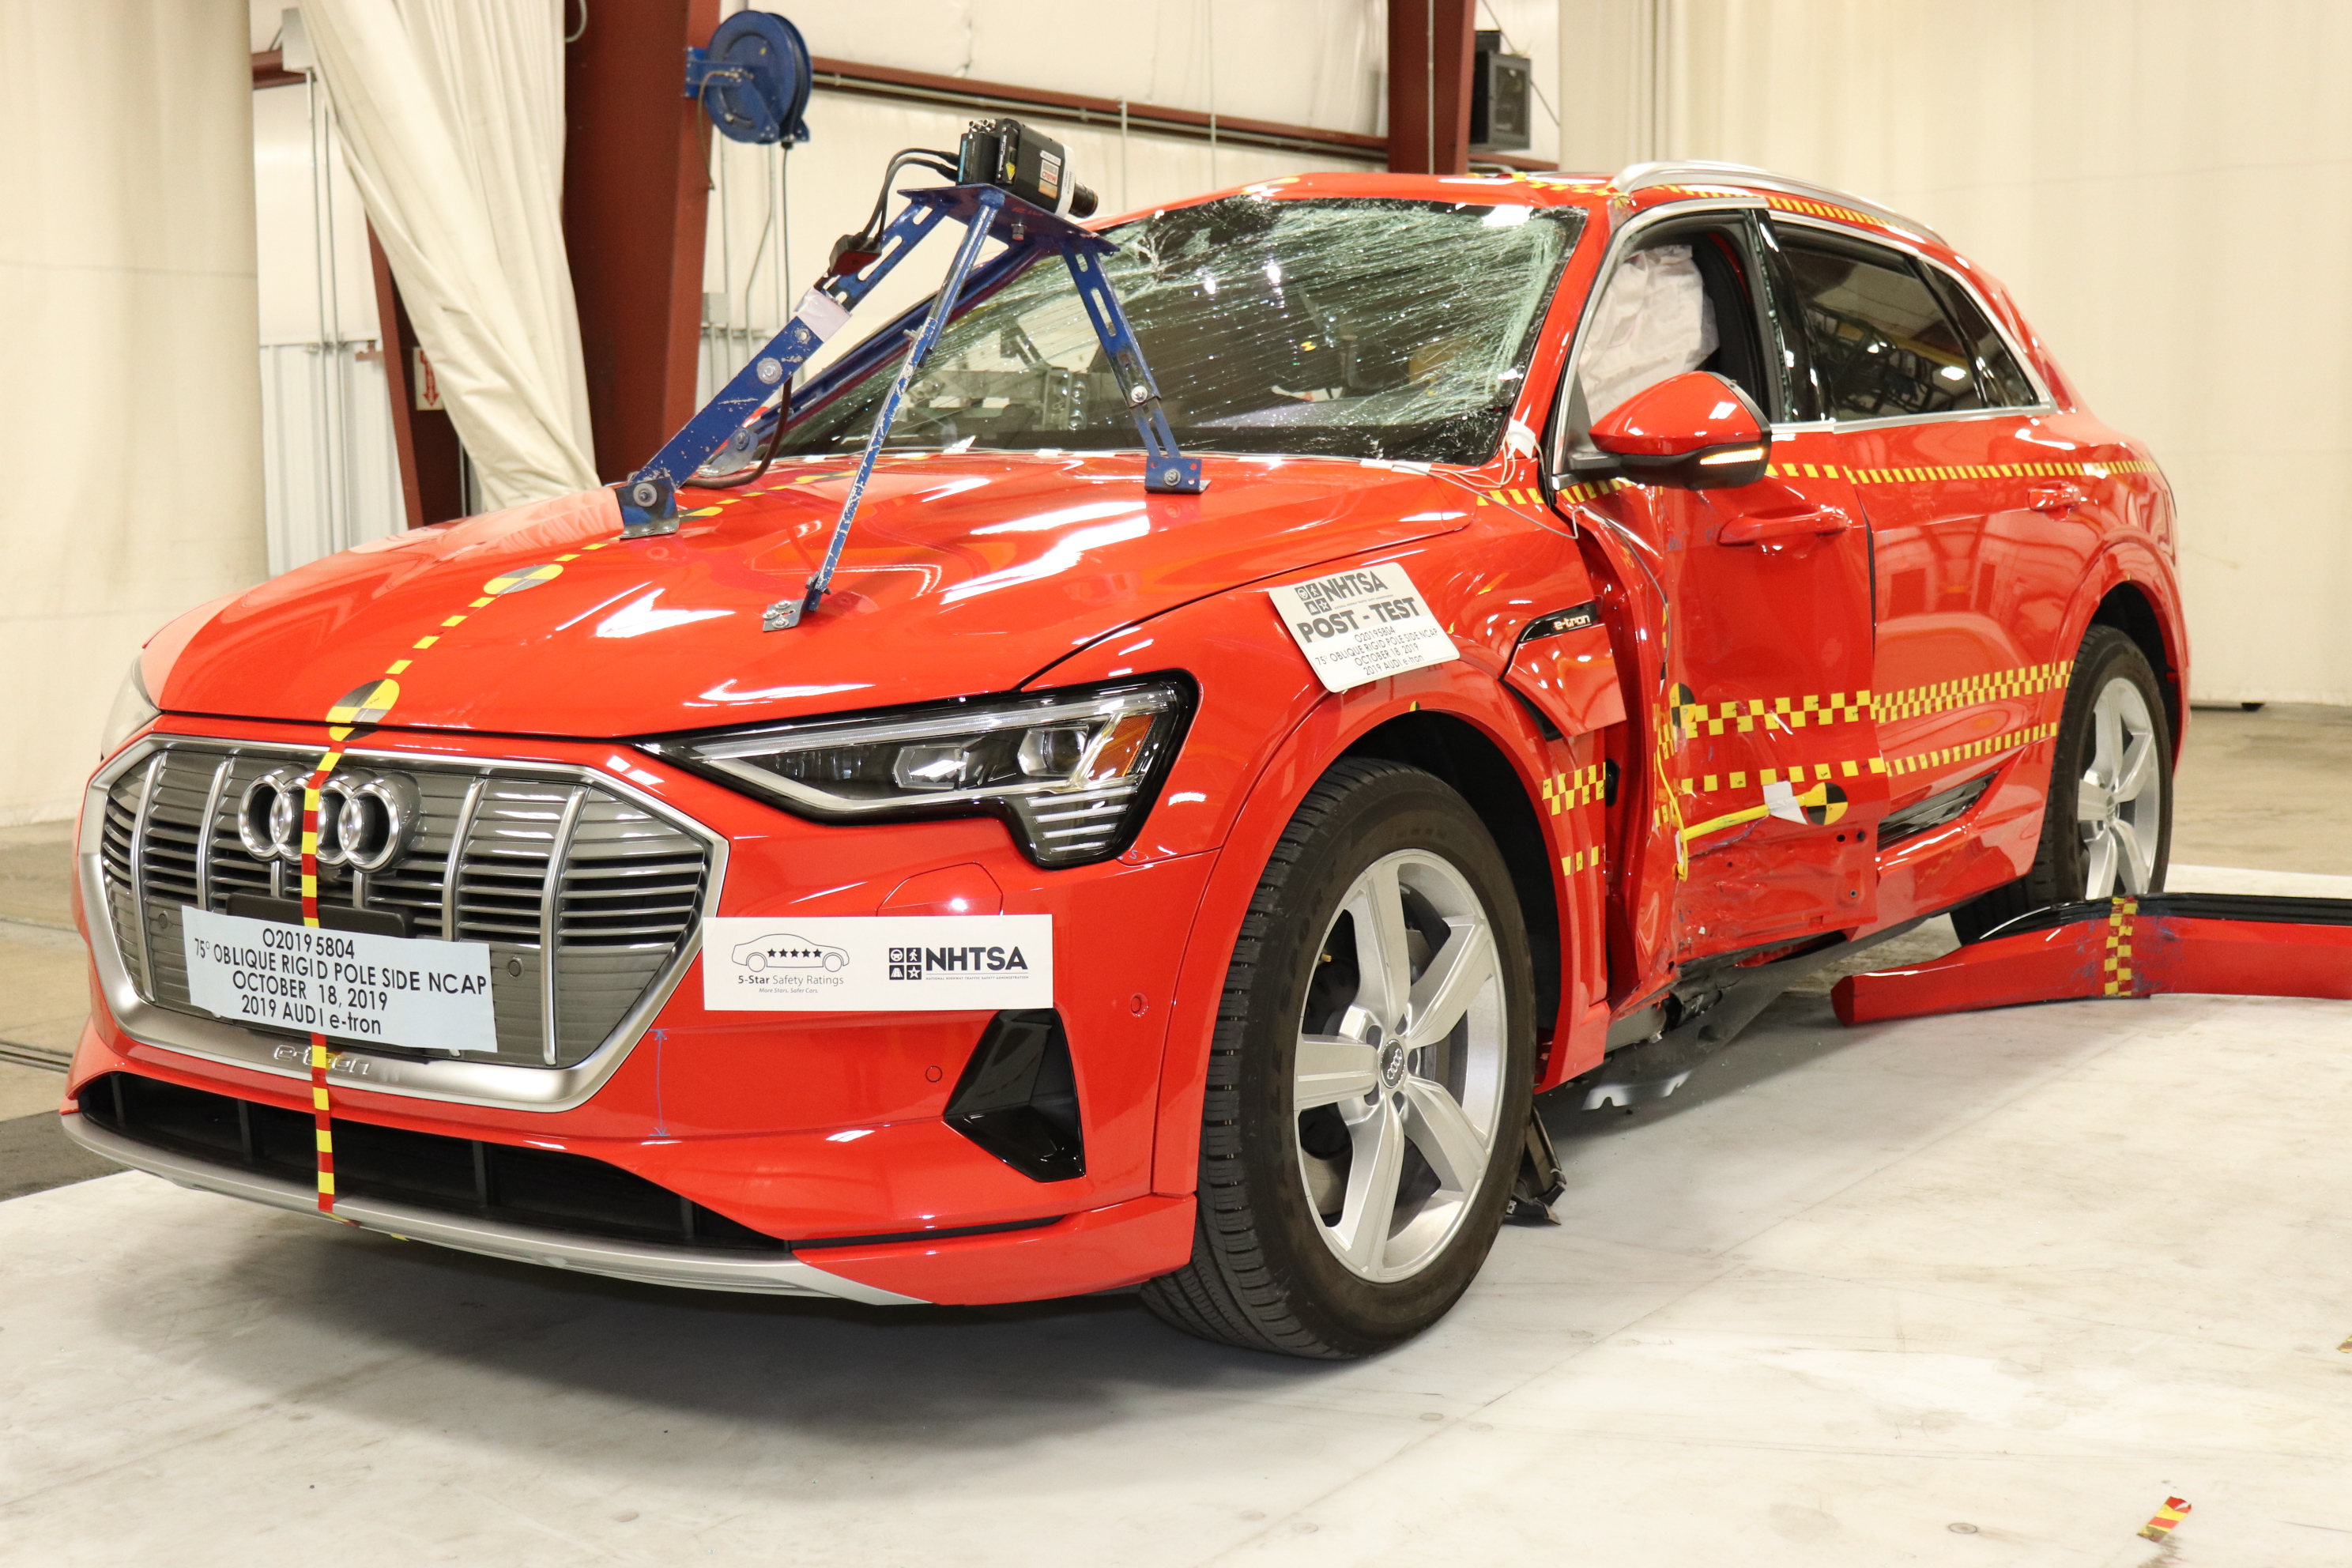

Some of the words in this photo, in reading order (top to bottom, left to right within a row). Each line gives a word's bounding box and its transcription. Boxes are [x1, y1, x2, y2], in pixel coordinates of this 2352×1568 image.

[1318, 571, 1388, 601] NHTSA
[1297, 609, 1359, 643] POST
[1368, 597, 1420, 623] TEST
[1554, 615, 1590, 631] e-tron
[1329, 645, 1365, 662] OBLIQUE
[1364, 639, 1386, 651] RIGID
[1387, 635, 1405, 646] POLE
[1404, 631, 1420, 643] SIDE
[1420, 628, 1438, 639] NCAP
[1355, 650, 1389, 666] OCTOBER
[1391, 647, 1404, 657] 18,
[1402, 643, 1419, 654] 2019
[1363, 663, 1382, 676] 2019
[1383, 658, 1403, 670] AUDI
[1403, 654, 1424, 665] e-tron
[213, 943, 277, 971] OBLIQUE
[282, 956, 328, 980] RIGID
[335, 963, 376, 986] POLE
[383, 968, 420, 991] SIDE
[428, 971, 487, 995] NCAP
[926, 946, 1028, 971] NHTSA
[232, 971, 306, 1000] OCTOBER
[318, 984, 342, 1009] 18,
[348, 988, 388, 1011] 2019
[738, 975, 770, 984] 5-Star
[772, 975, 804, 986] Safety
[806, 975, 844, 986] Ratings
[242, 994, 277, 1018] 2019
[282, 1001, 324, 1027] AUDI
[329, 1012, 382, 1035] e-tron
[273, 1045, 371, 1075] e-ton
